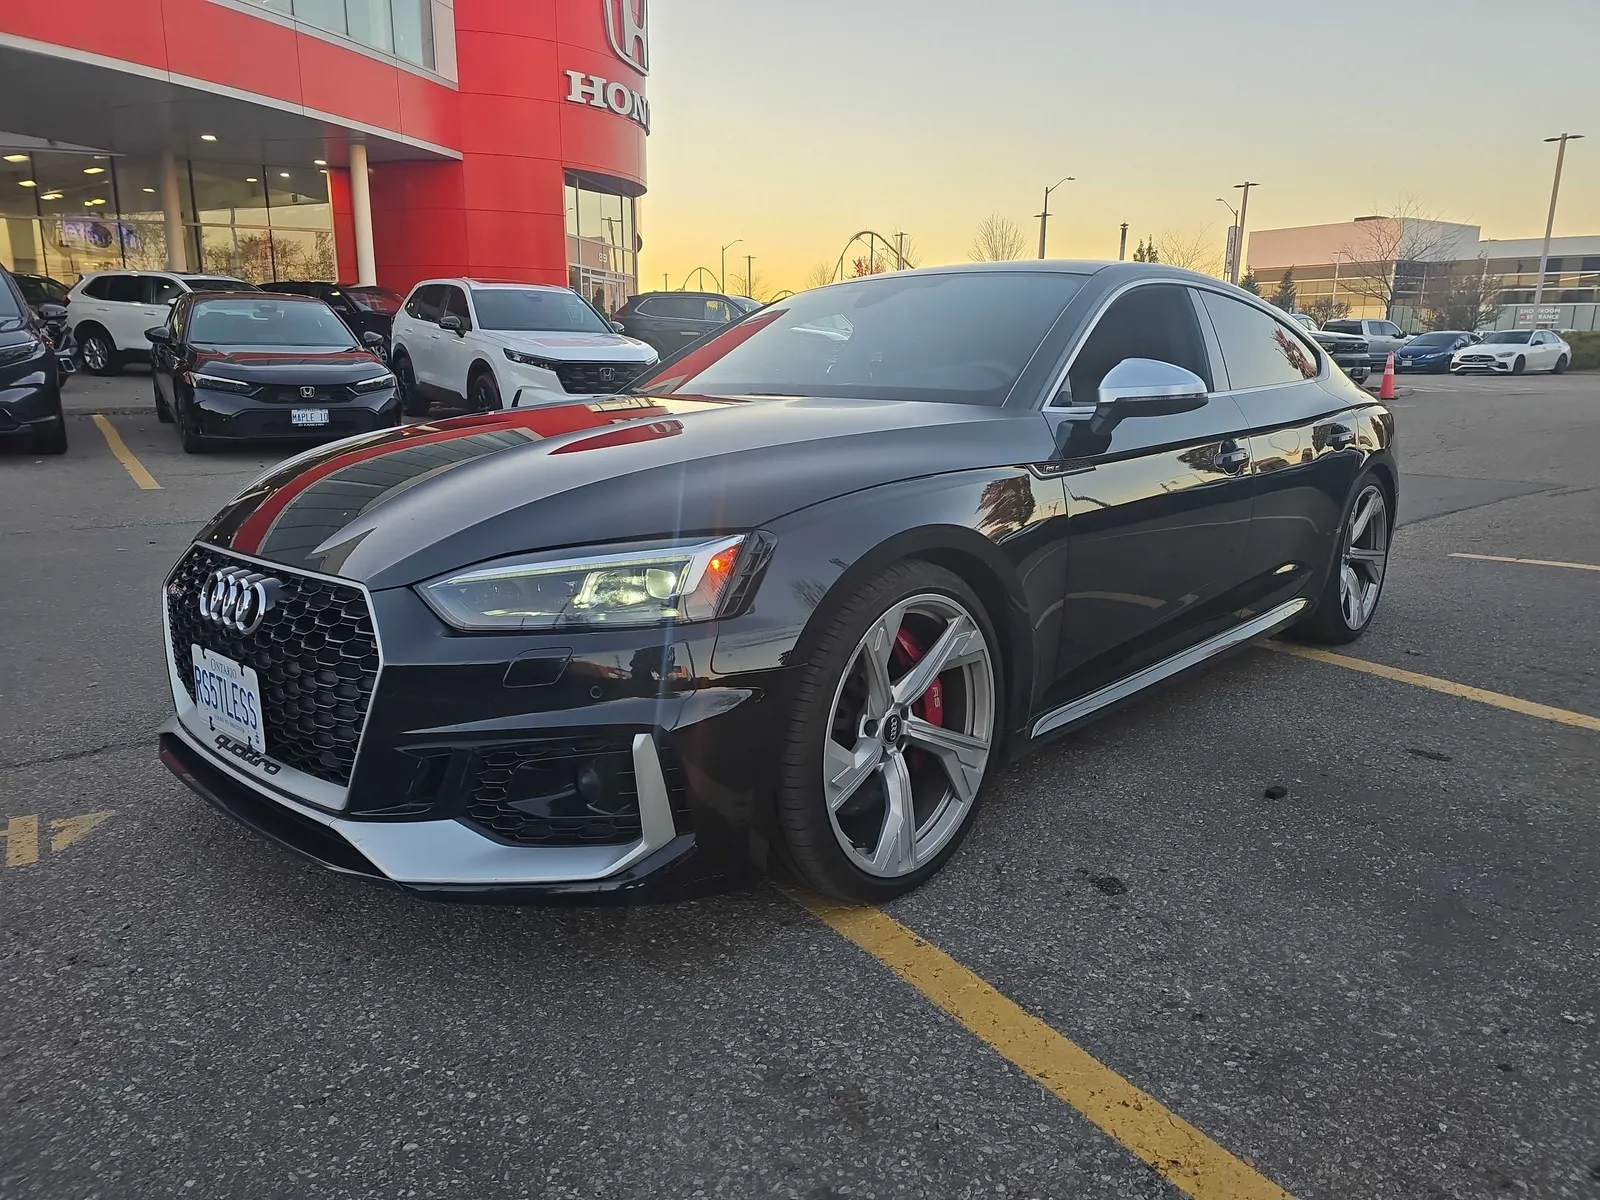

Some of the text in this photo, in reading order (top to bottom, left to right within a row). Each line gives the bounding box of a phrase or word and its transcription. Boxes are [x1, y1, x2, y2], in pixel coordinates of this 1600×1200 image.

[566, 69, 651, 136] HON
[598, 252, 608, 263] 89
[292, 412, 315, 422] MAPLE
[210, 658, 238, 679] ONTARIO
[194, 664, 258, 730] RS5TLESS
[931, 686, 942, 709] RS
[214, 734, 282, 776] quattro
